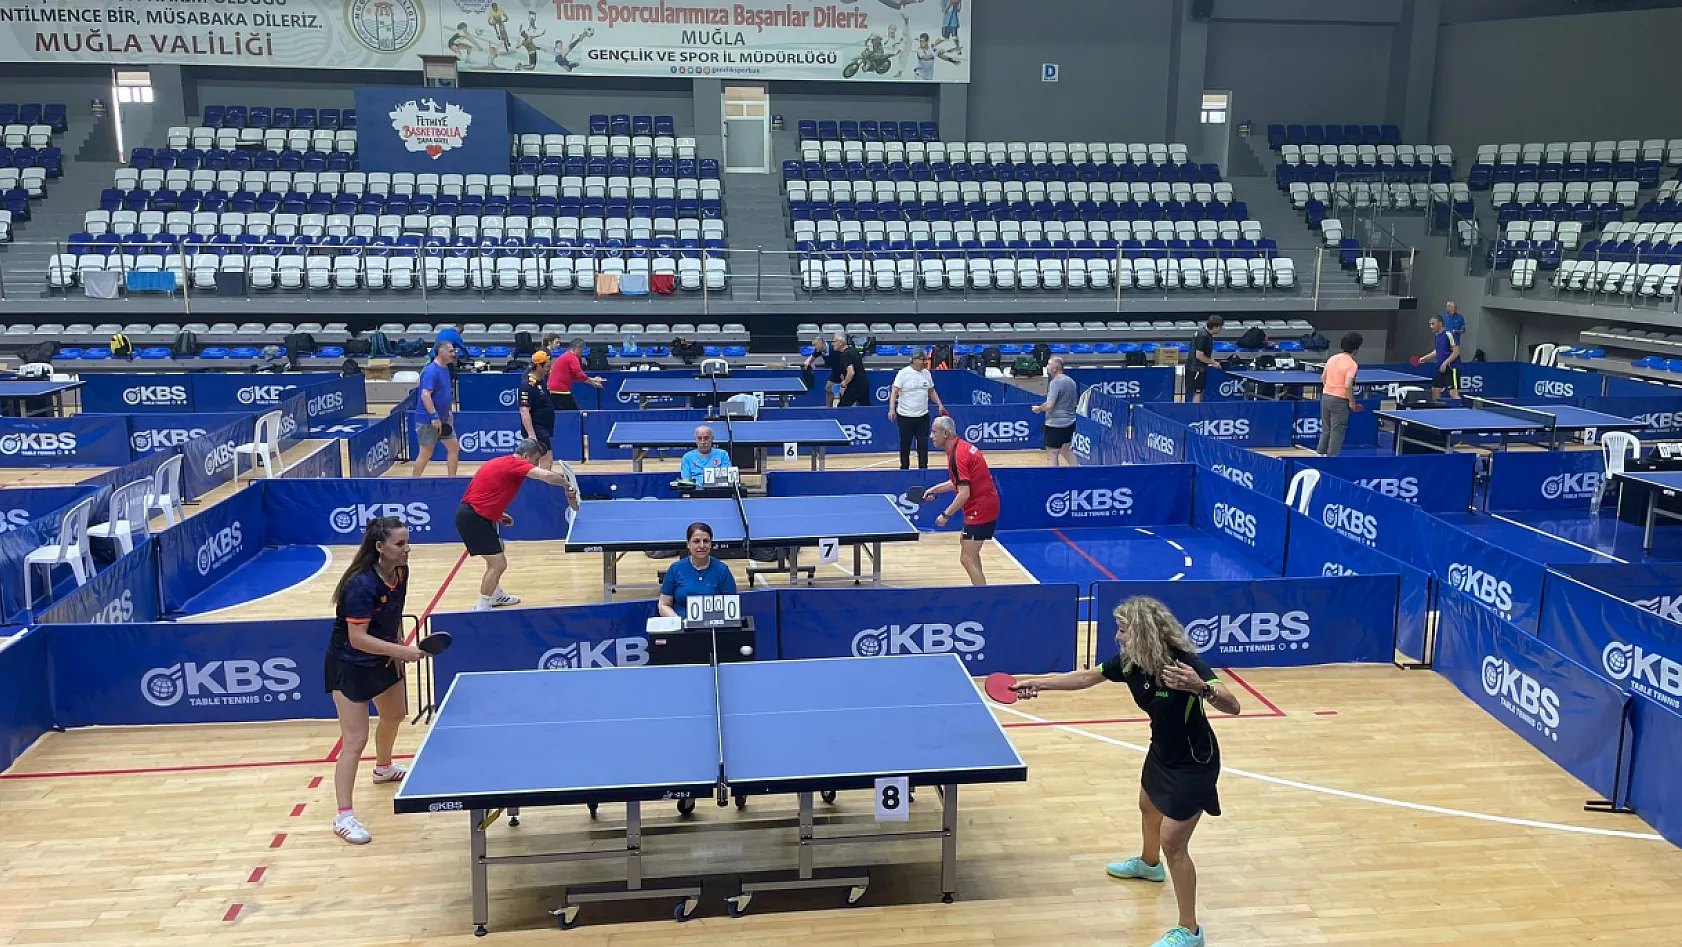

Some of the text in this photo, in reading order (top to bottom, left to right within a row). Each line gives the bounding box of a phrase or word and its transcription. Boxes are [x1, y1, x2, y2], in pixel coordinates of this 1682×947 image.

[0, 5, 323, 29] NTİLMENCE BİR, MÜSABAKA DİLERİZ.
[553, 0, 868, 33] Tüm Sporcularımıza Başarılar Dileriz
[35, 28, 273, 56] MUĞLA VALİLİĞİ
[681, 28, 746, 46] MUĞLA
[587, 48, 837, 64] GENÇLİK VE SPOR İL MÜDÜRLÜĞÜ
[1044, 65, 1056, 77] D
[402, 125, 462, 138] BASKETBOLLA
[1103, 380, 1140, 394] KBS
[1460, 375, 1483, 389] BS
[1544, 381, 1574, 397] KBS
[140, 385, 187, 400] KBS
[256, 385, 297, 400] KB
[317, 391, 343, 412] KBS
[843, 423, 873, 441] BS
[983, 420, 1029, 439] KBS
[1203, 418, 1250, 436] KBS
[20, 431, 76, 451] KBS
[371, 438, 389, 462] KBS
[786, 445, 794, 456] 6
[1155, 433, 1175, 455] KBS
[213, 440, 236, 468] KBS
[1562, 471, 1605, 493] KB
[1071, 486, 1134, 510] KBS
[1224, 503, 1257, 539] KBS
[1337, 505, 1378, 540] KBS
[208, 521, 242, 562] KBS
[823, 543, 834, 558] 7
[1464, 564, 1512, 612] KBS
[690, 601, 700, 621] 0
[727, 601, 736, 619] 0
[1218, 610, 1310, 643] KBS
[890, 620, 986, 654] KBS
[1219, 643, 1276, 654] TABLE TENNIS
[183, 656, 301, 695] KBS
[189, 695, 261, 707] TABLE TENNIS
[1501, 661, 1560, 729] KBS
[882, 785, 900, 810] 8
